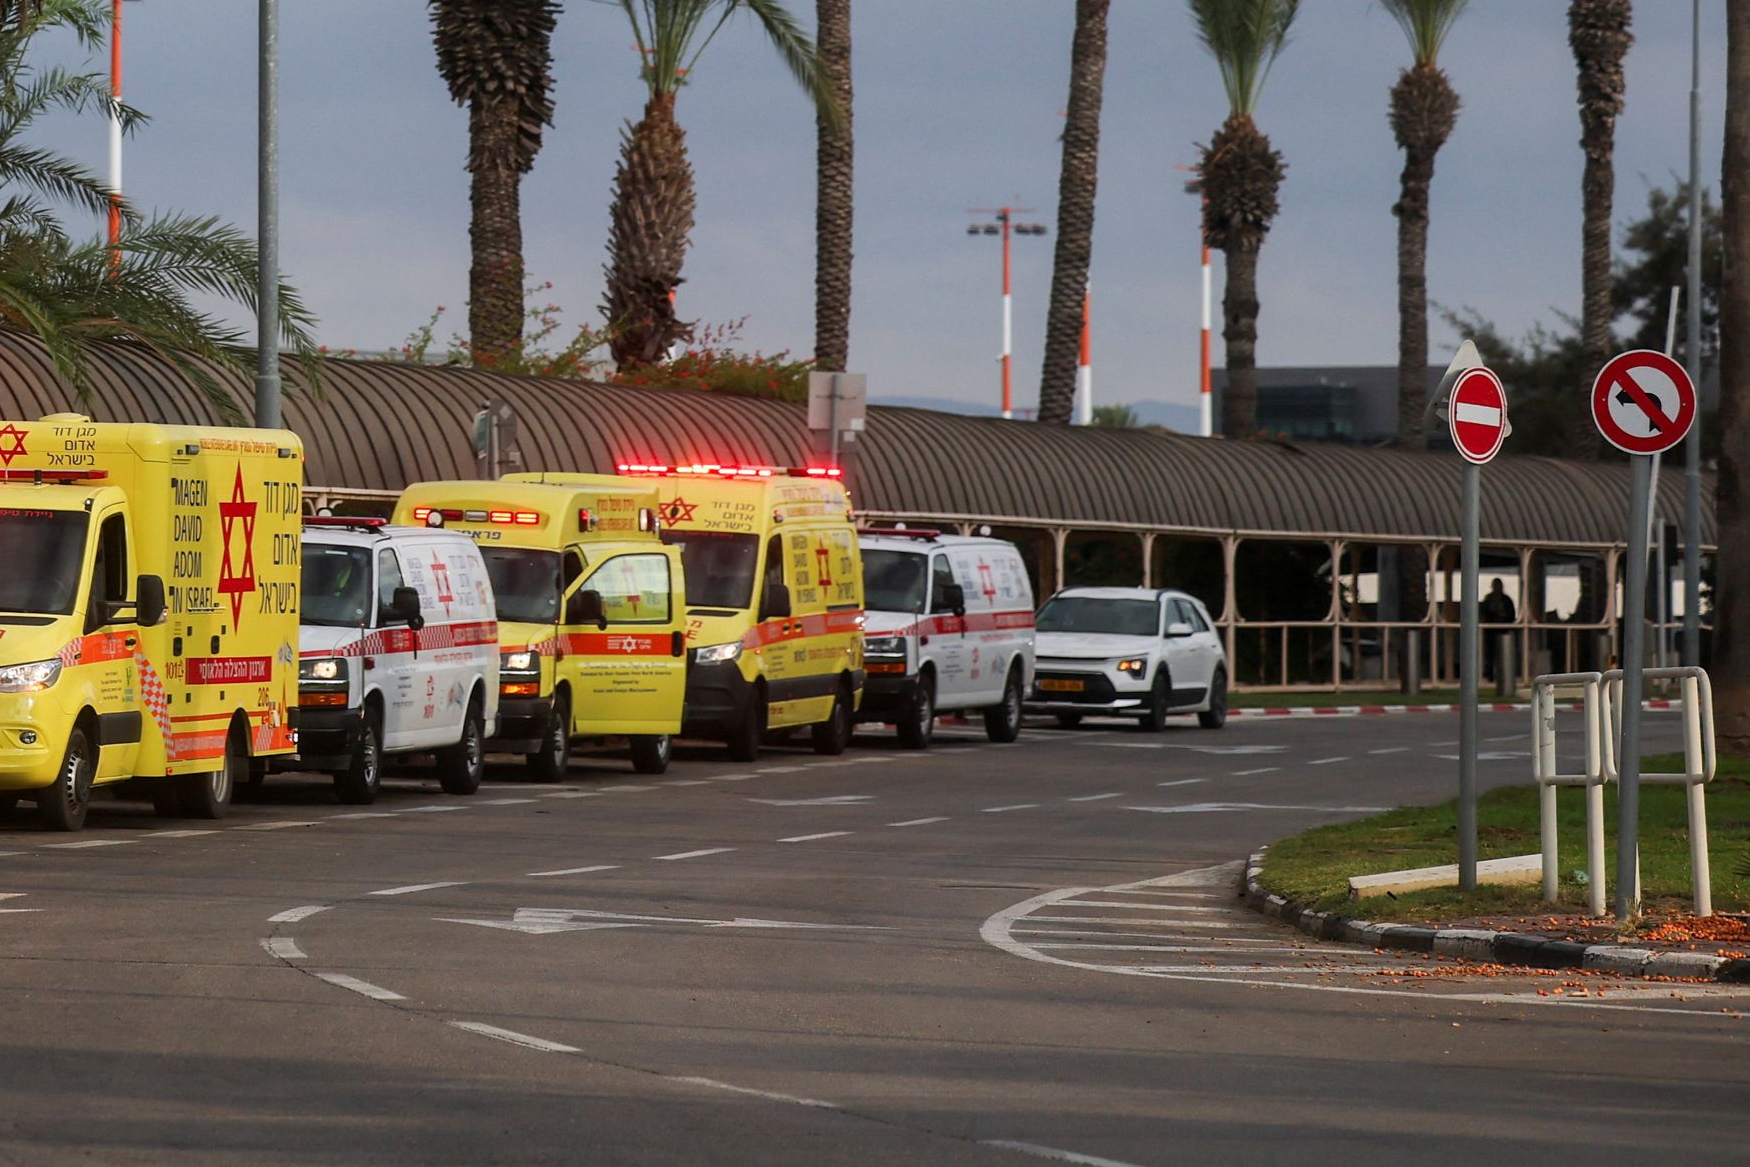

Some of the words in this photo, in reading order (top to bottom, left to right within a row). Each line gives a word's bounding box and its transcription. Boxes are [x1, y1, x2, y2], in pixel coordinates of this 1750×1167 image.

[52, 426, 74, 436] דוד
[75, 427, 97, 438] מגן
[47, 452, 95, 466] בישראל
[64, 440, 95, 451] אדום
[175, 478, 208, 507] MAGEN
[264, 481, 280, 514] דוד
[282, 482, 299, 521] מגן
[174, 515, 203, 542] DAVID
[273, 534, 298, 565] אדום
[173, 551, 202, 578] ADOM
[172, 586, 183, 614] IN
[185, 586, 213, 613] ISRAEL
[258, 575, 297, 614] בישראל
